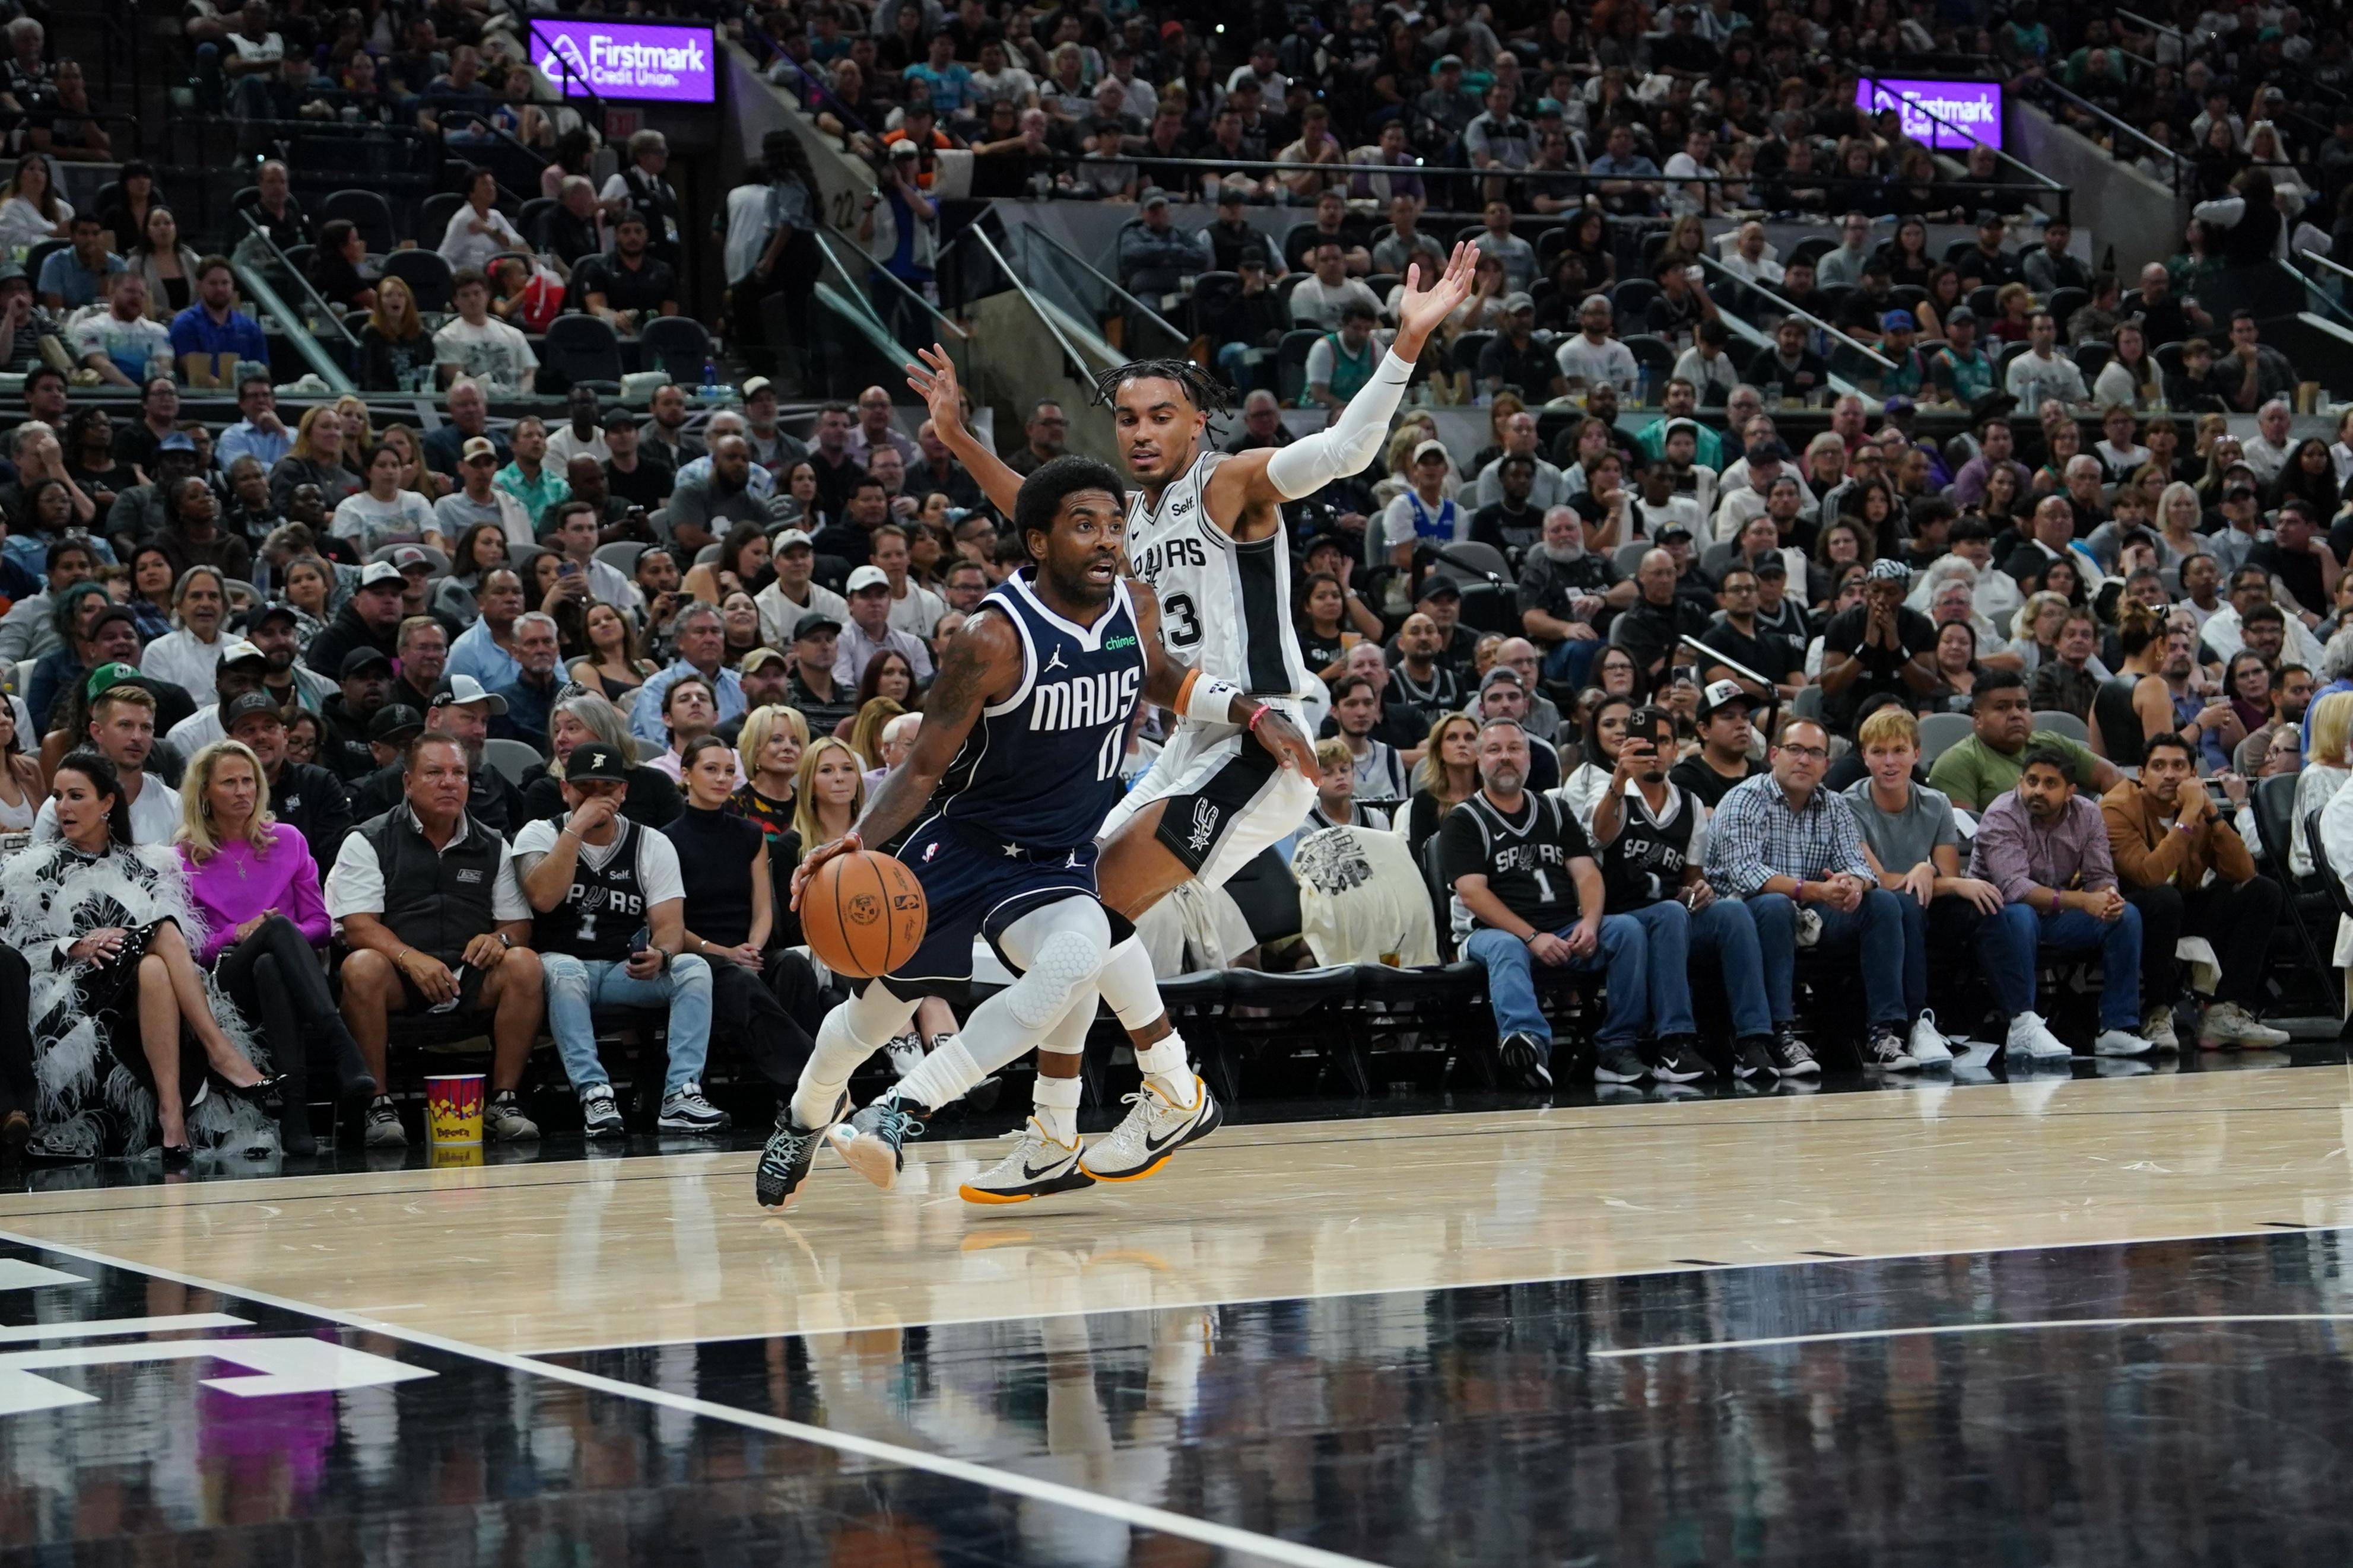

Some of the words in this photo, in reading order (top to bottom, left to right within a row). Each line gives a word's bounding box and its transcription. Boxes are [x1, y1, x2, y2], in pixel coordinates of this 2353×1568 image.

[589, 34, 706, 72] Firstmark
[590, 65, 633, 85] Credit
[833, 189, 855, 233] 22
[1134, 537, 1206, 587] PURS
[1106, 635, 1136, 651] chime
[1030, 665, 1140, 731] MAVS
[1495, 844, 1565, 873] SPURS
[1624, 838, 1686, 872] SPURS
[566, 883, 642, 915] PURS
[1533, 868, 1556, 902] 1
[576, 914, 598, 941] 1
